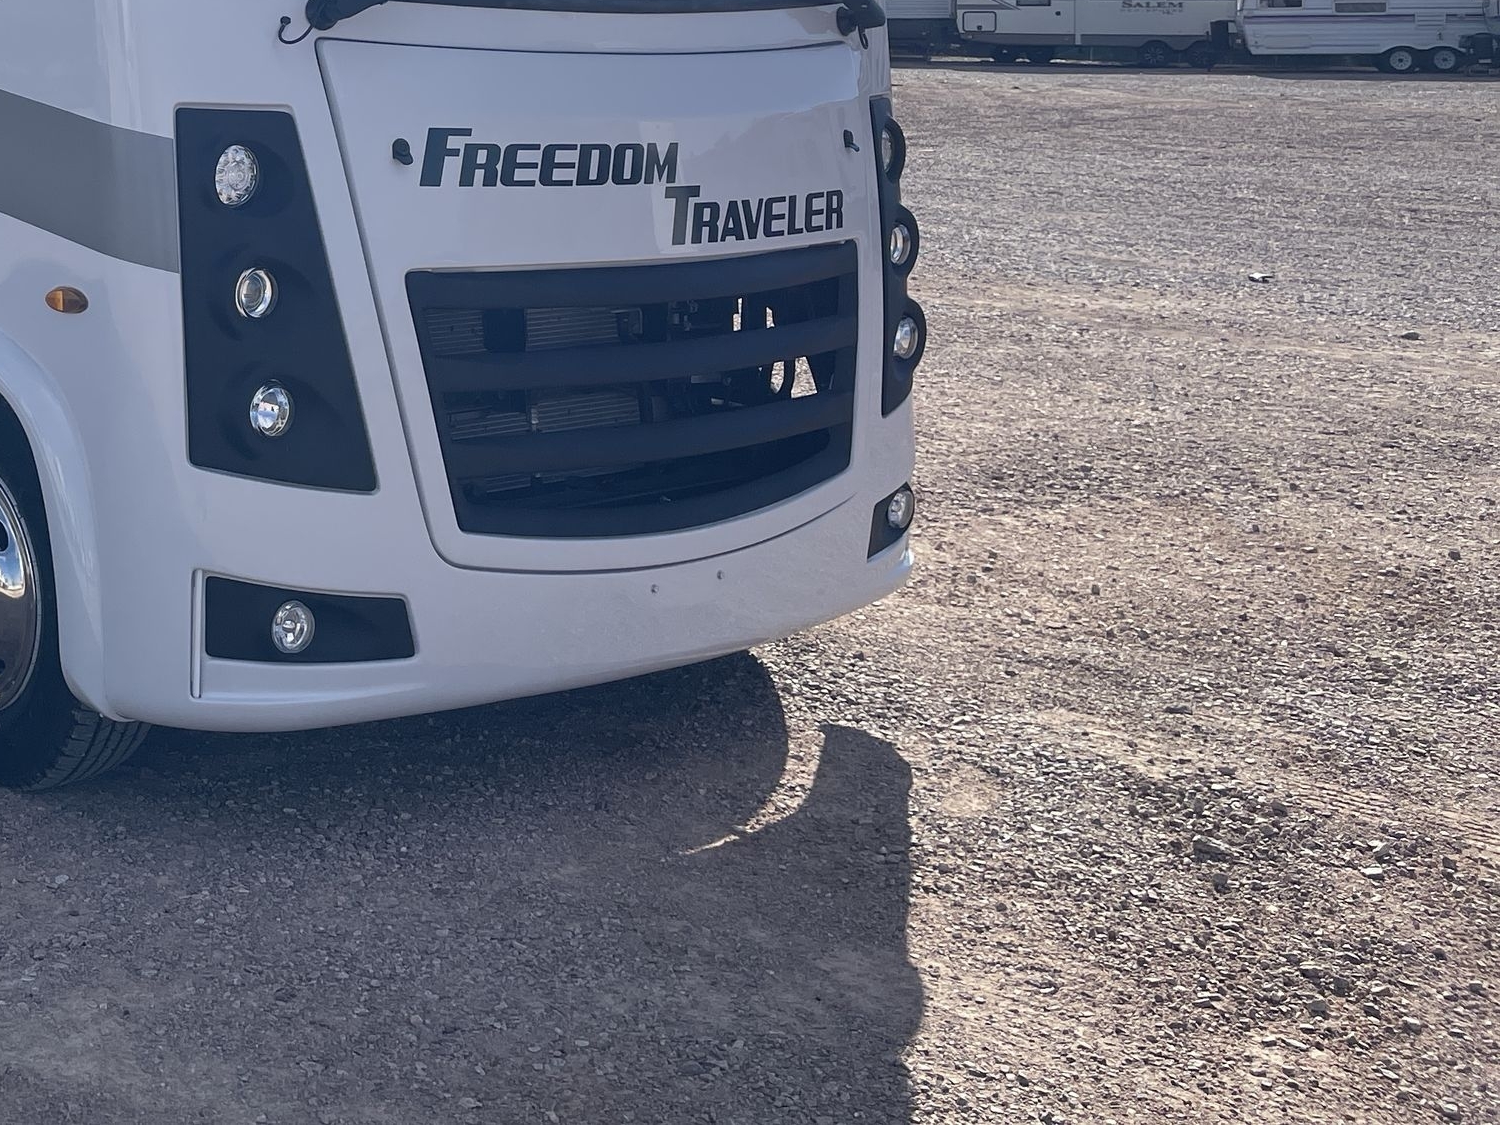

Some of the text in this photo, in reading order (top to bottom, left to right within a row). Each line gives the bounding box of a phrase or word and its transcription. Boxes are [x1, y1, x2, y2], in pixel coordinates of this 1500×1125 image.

[1122, 0, 1184, 9] SALEM
[419, 127, 679, 187] FREEDOM
[664, 186, 844, 246] TRAVELER
